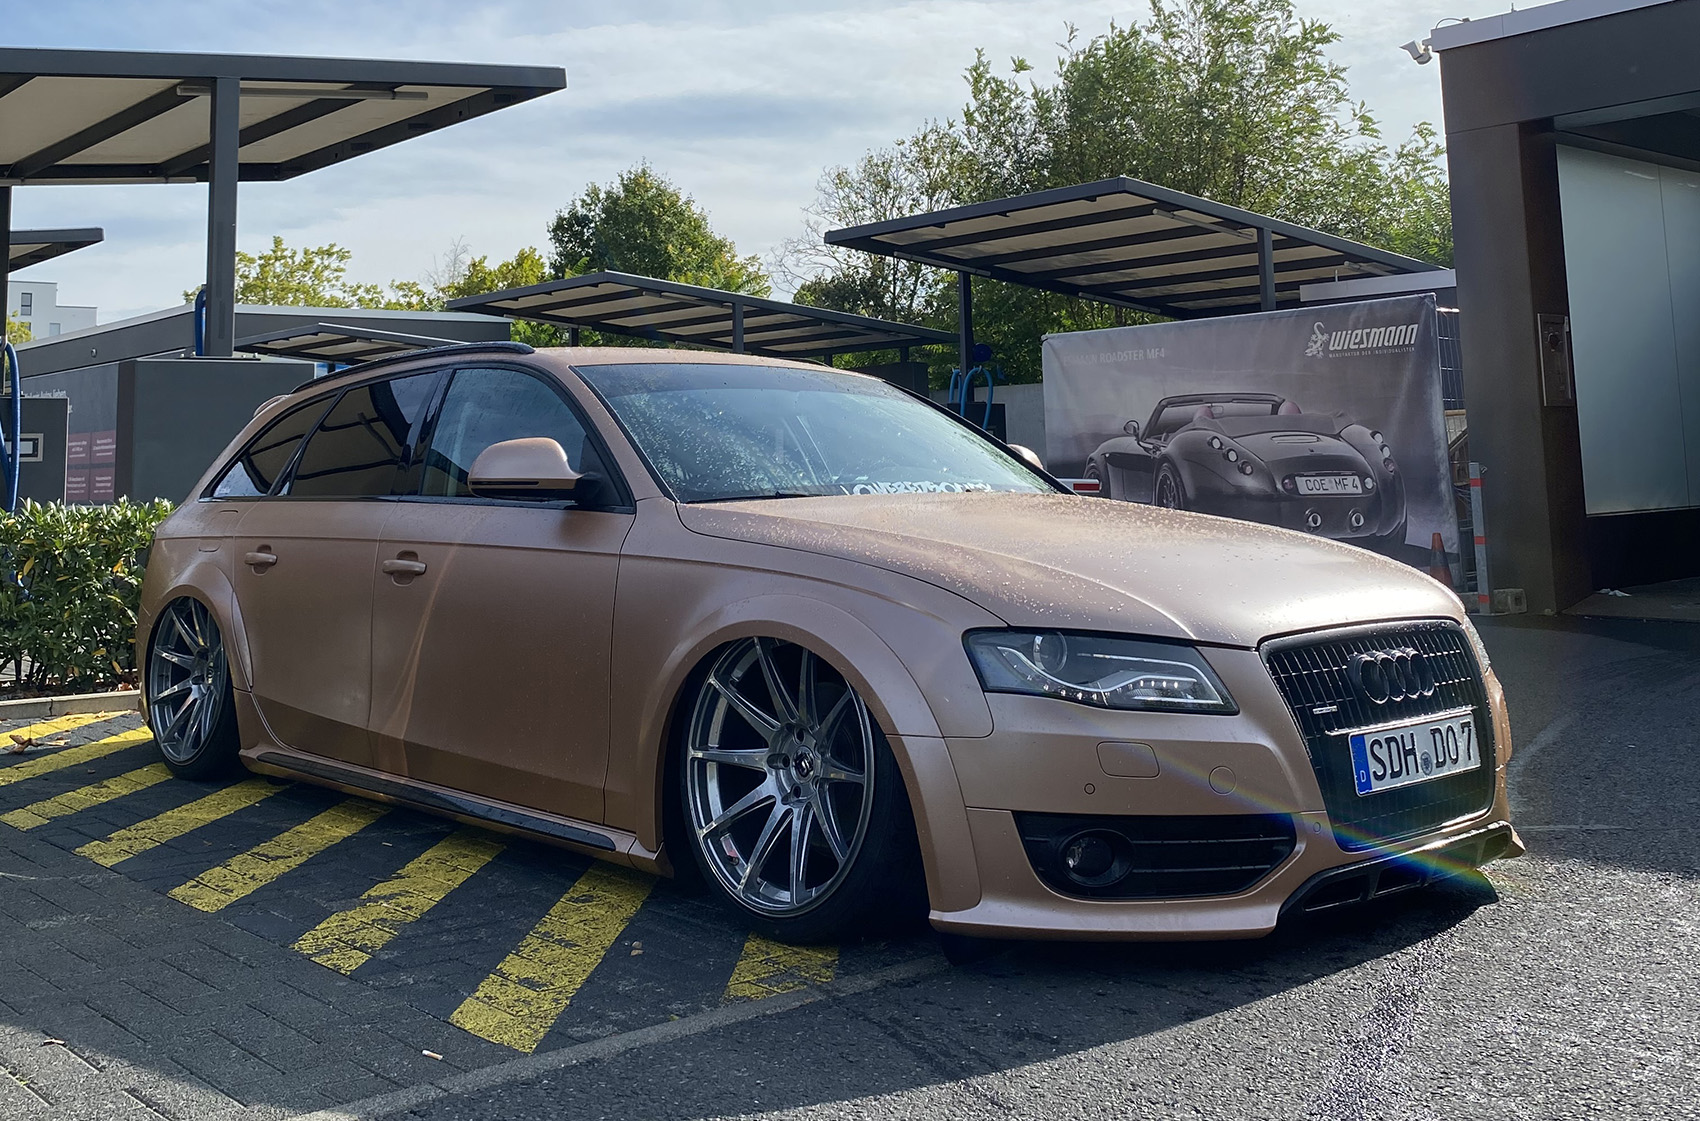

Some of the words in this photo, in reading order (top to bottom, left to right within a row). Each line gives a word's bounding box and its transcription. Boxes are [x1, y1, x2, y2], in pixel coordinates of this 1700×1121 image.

[1100, 350, 1144, 364] ROADSTER
[1146, 347, 1165, 360] MF4
[1305, 479, 1329, 491] COE
[1334, 478, 1349, 490] MF
[1352, 478, 1359, 490] 4
[1359, 770, 1367, 783] D
[1369, 732, 1419, 782] SDH
[1430, 723, 1459, 768] DO
[1460, 719, 1473, 761] 7
